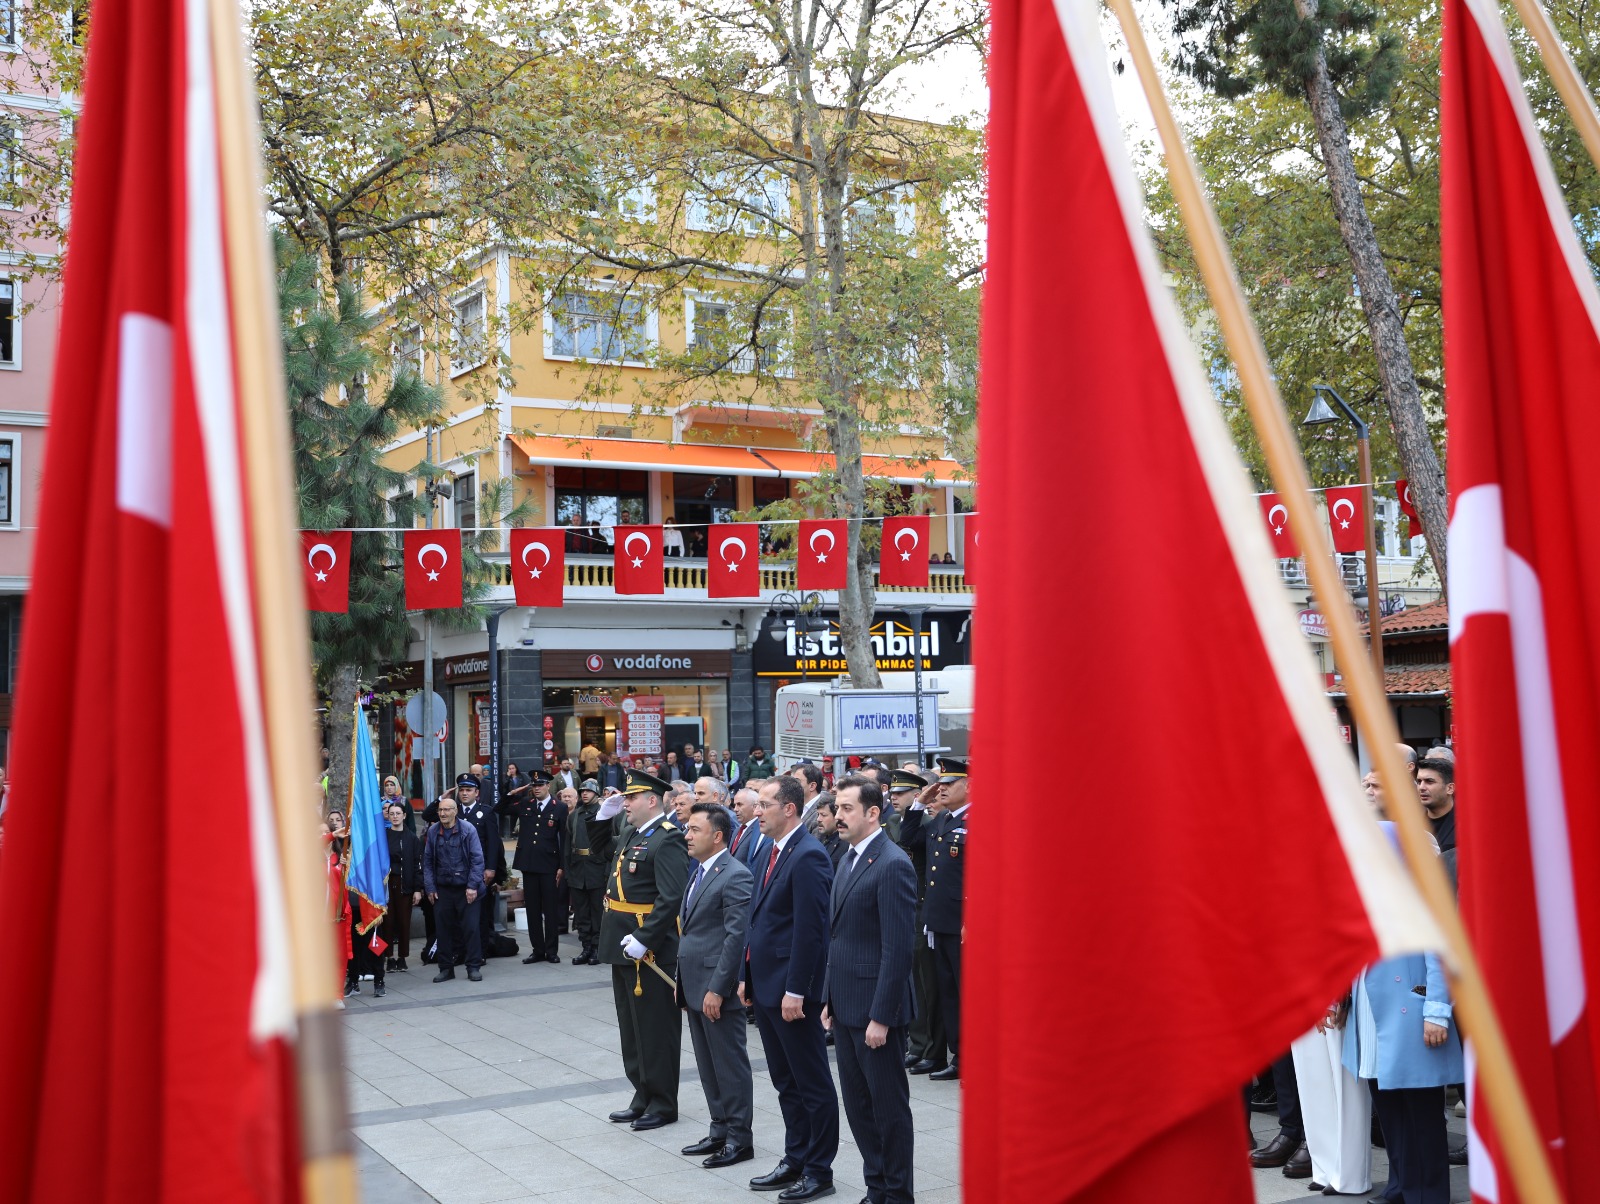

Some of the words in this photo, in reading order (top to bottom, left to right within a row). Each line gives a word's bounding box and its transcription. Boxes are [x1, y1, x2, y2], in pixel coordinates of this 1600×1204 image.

[453, 657, 488, 675] vodafone
[613, 654, 692, 669] vodafone
[796, 659, 817, 669] KIR
[874, 659, 931, 669] AHMACN
[854, 712, 894, 730] ATATÜRK
